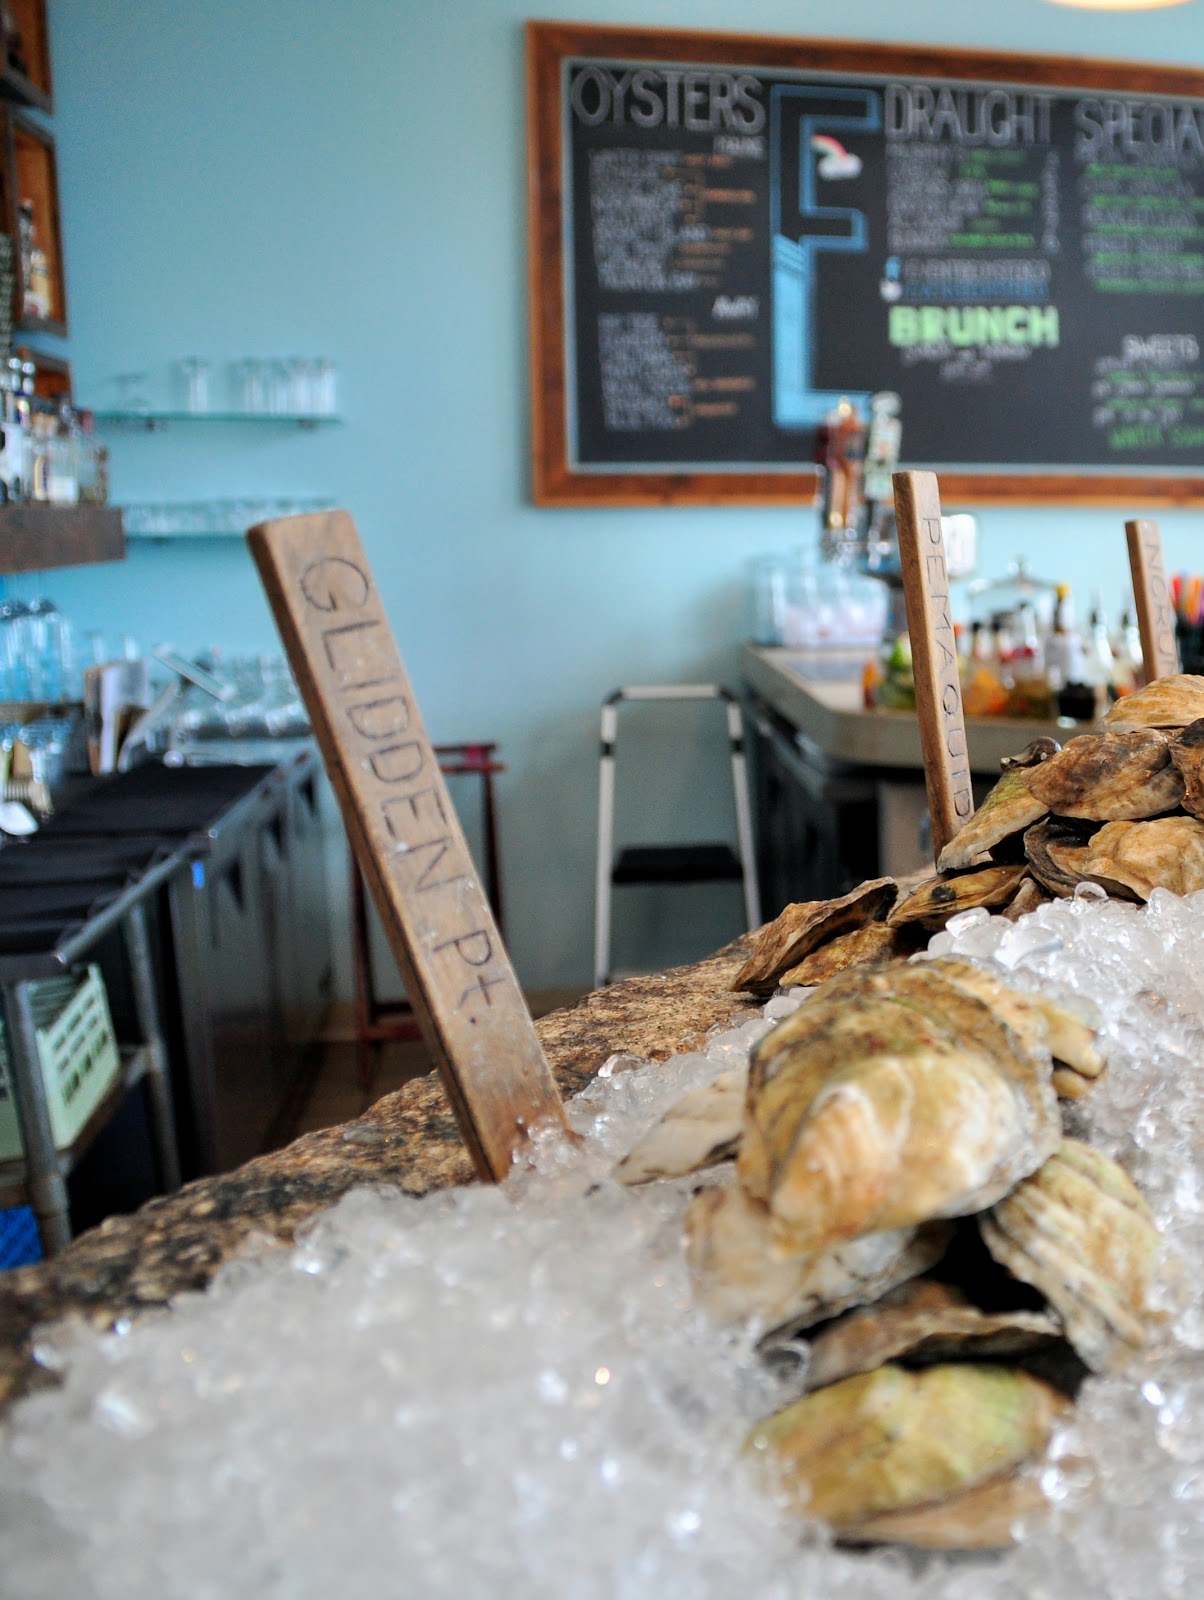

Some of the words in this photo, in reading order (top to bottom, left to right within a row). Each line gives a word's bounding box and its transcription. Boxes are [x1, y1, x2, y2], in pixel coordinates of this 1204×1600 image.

[571, 66, 767, 135] OYSTERS
[885, 84, 1053, 146] DRAUGHT
[888, 305, 1060, 349] BRUNCH
[921, 517, 970, 818] PEMAQUID
[300, 555, 467, 894] GLIDDEN
